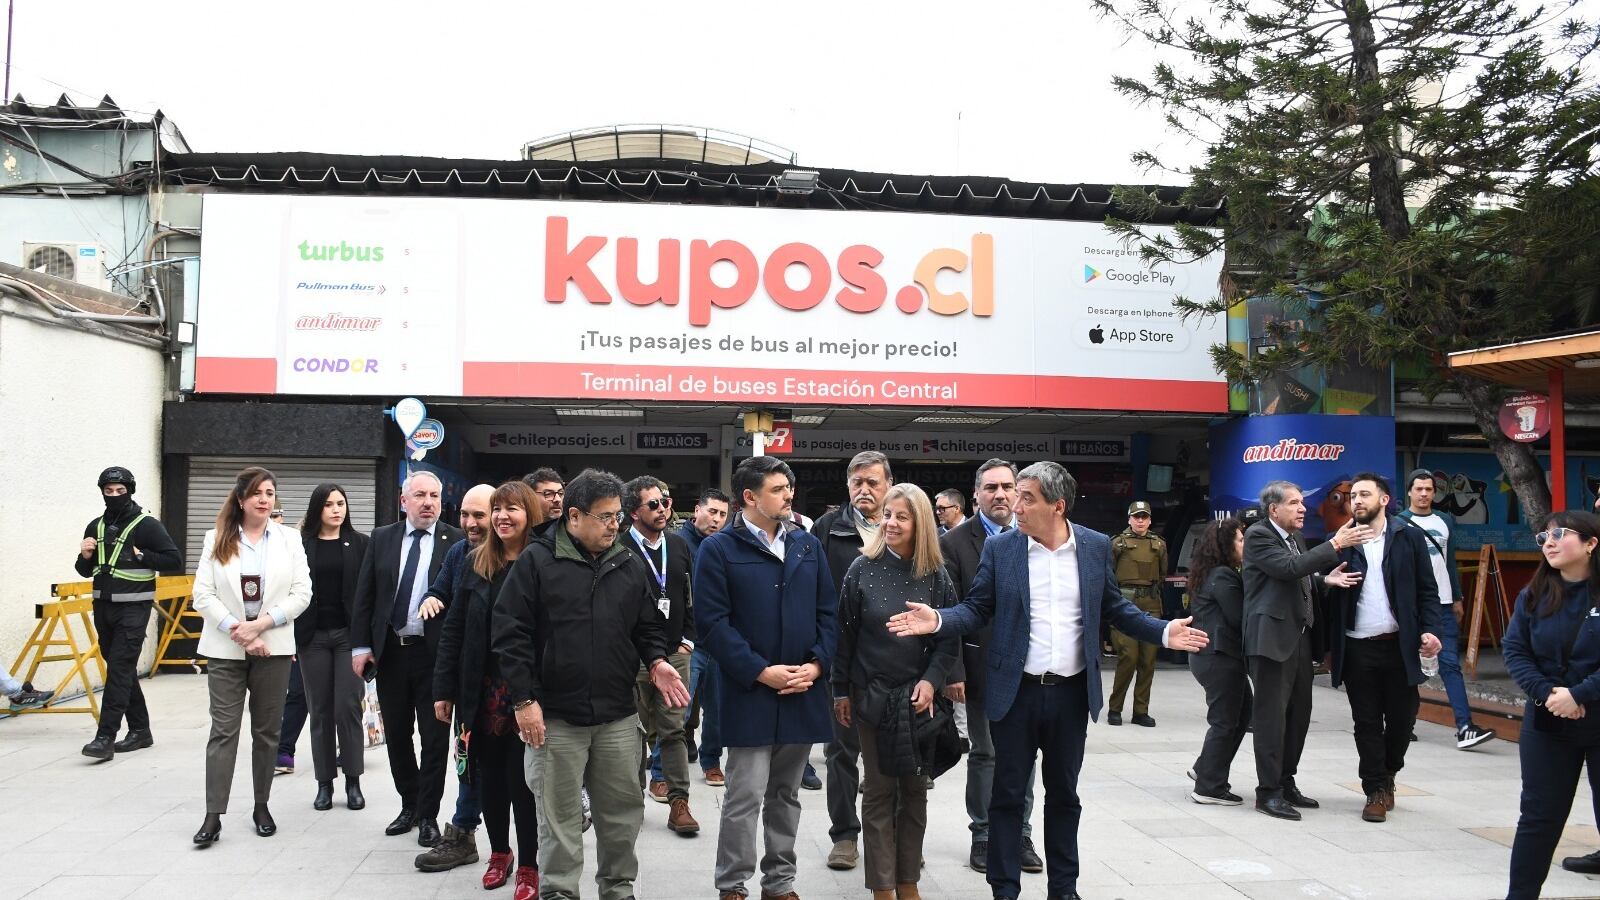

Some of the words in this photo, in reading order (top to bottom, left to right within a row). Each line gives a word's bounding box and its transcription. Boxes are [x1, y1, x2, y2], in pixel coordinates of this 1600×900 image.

[297, 240, 384, 262] turbus
[1084, 246, 1125, 257] Descarga
[544, 215, 994, 328] kupos.cl
[1105, 268, 1149, 285] Google
[1151, 271, 1176, 286] Play
[296, 282, 348, 291] Pullman
[350, 283, 375, 291] Bus
[1087, 306, 1129, 317] Descarga
[1143, 308, 1173, 318] Iphone
[295, 311, 382, 332] andimar
[1109, 328, 1137, 343] App
[1139, 329, 1174, 343] Store
[579, 330, 623, 351] ¡Tus
[629, 334, 713, 355] pasajes
[718, 333, 746, 352] de
[750, 334, 790, 354] bus
[795, 336, 814, 354] al
[818, 338, 880, 359] mejor
[884, 340, 958, 358] precio!
[293, 358, 379, 373] CONDOR
[580, 371, 673, 393] Terminal
[679, 373, 706, 394] de
[713, 374, 777, 396] buses
[784, 377, 875, 398] Estación
[880, 380, 958, 400] Central
[1284, 382, 1309, 401] SUSHI
[414, 431, 437, 440] Savory
[508, 432, 625, 449] chilepasajes.cl
[658, 433, 701, 447] BAÑOS
[810, 440, 857, 450] pasajes
[861, 439, 876, 450] de
[879, 440, 900, 451] bus
[903, 443, 919, 451] en
[940, 439, 1049, 454] chilepasajes.cl
[1079, 442, 1120, 455] BAÑOS
[1243, 438, 1344, 463] andimar
